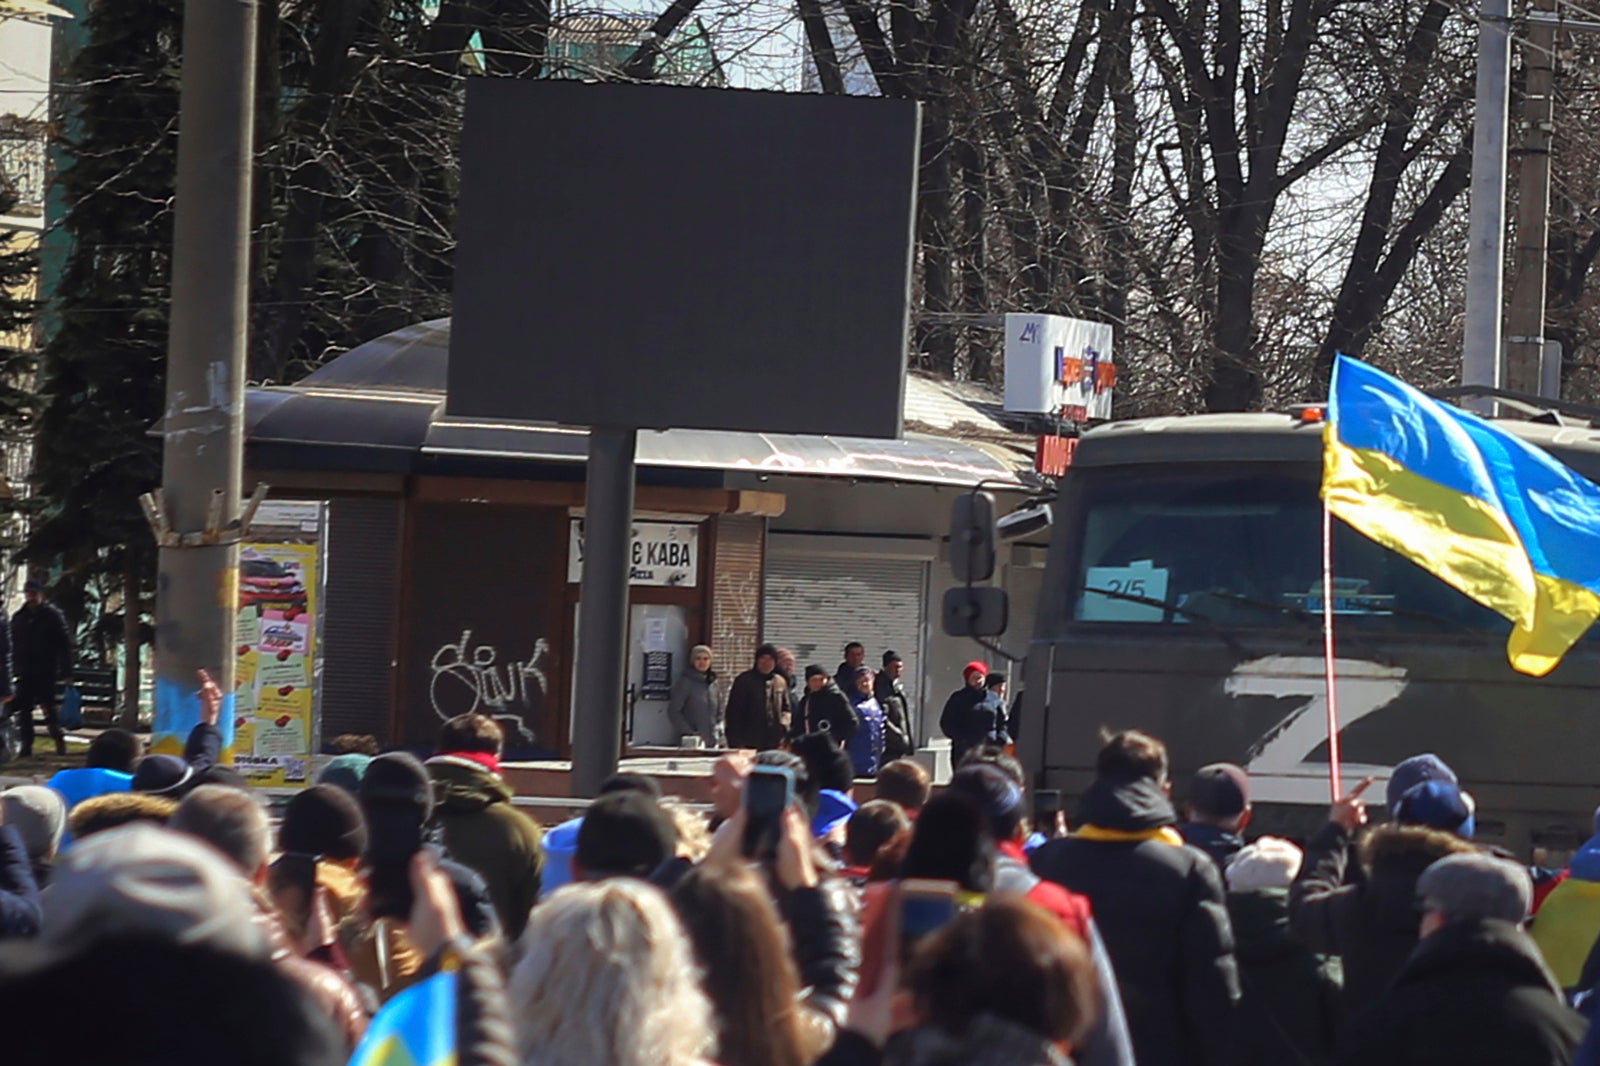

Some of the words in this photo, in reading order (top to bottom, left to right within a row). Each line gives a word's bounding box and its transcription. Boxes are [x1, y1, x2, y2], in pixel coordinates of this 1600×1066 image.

[647, 542, 690, 567] КАВА
[1107, 579, 1145, 599] 2/5
[1224, 655, 1408, 806] Z
